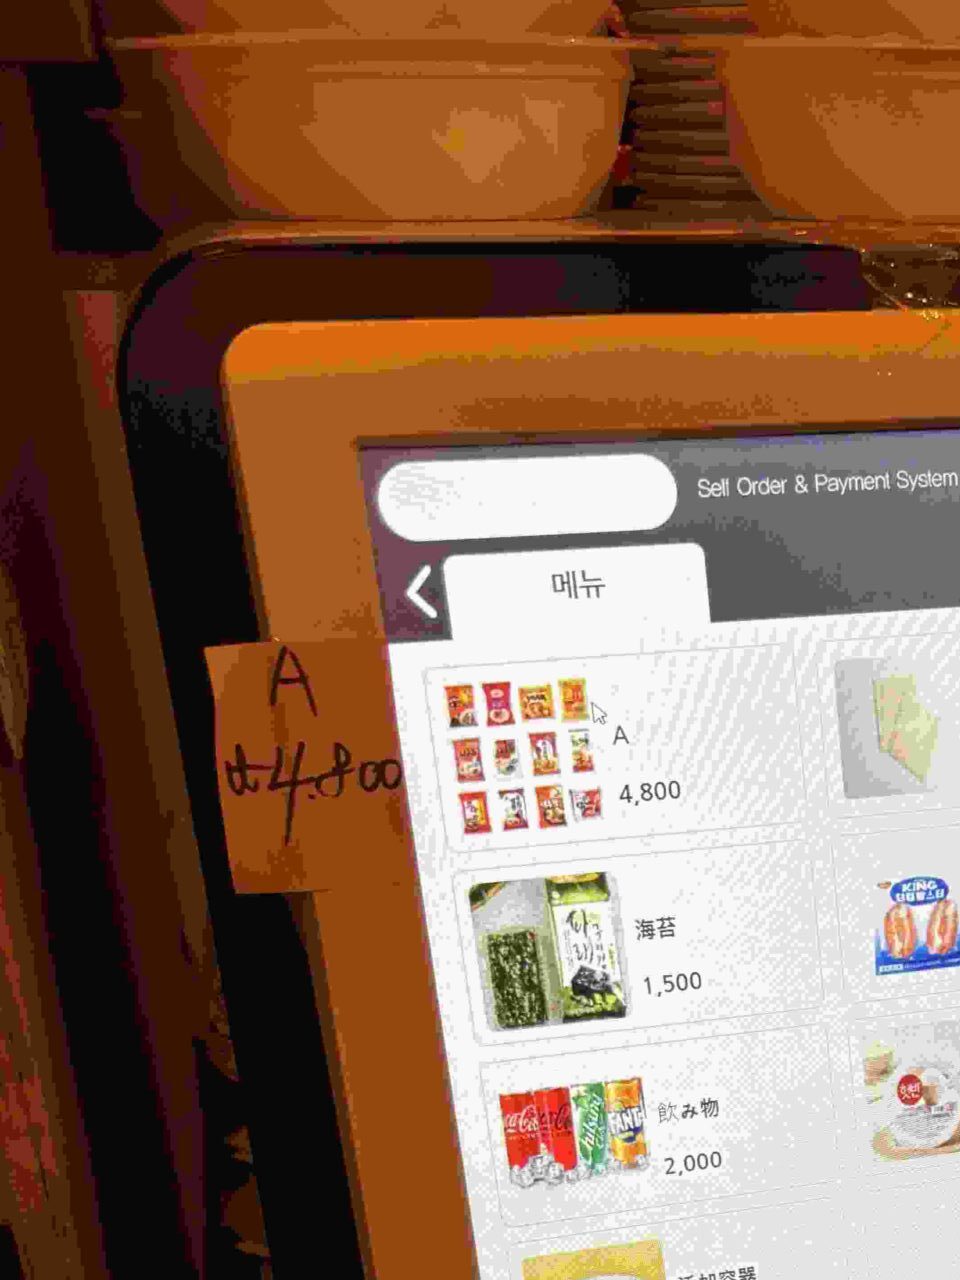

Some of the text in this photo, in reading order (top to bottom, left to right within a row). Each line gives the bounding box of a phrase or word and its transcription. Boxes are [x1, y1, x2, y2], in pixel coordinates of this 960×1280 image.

[698, 470, 959, 499] Sell Order & Payment System
[551, 569, 606, 599] 메뉴
[268, 645, 319, 718] A
[612, 725, 630, 746] A
[618, 780, 682, 806] 4,800
[634, 917, 677, 942] 海苔
[643, 971, 703, 998] 1,500
[657, 1098, 720, 1124] 飲み物
[664, 1151, 722, 1177] 2,000
